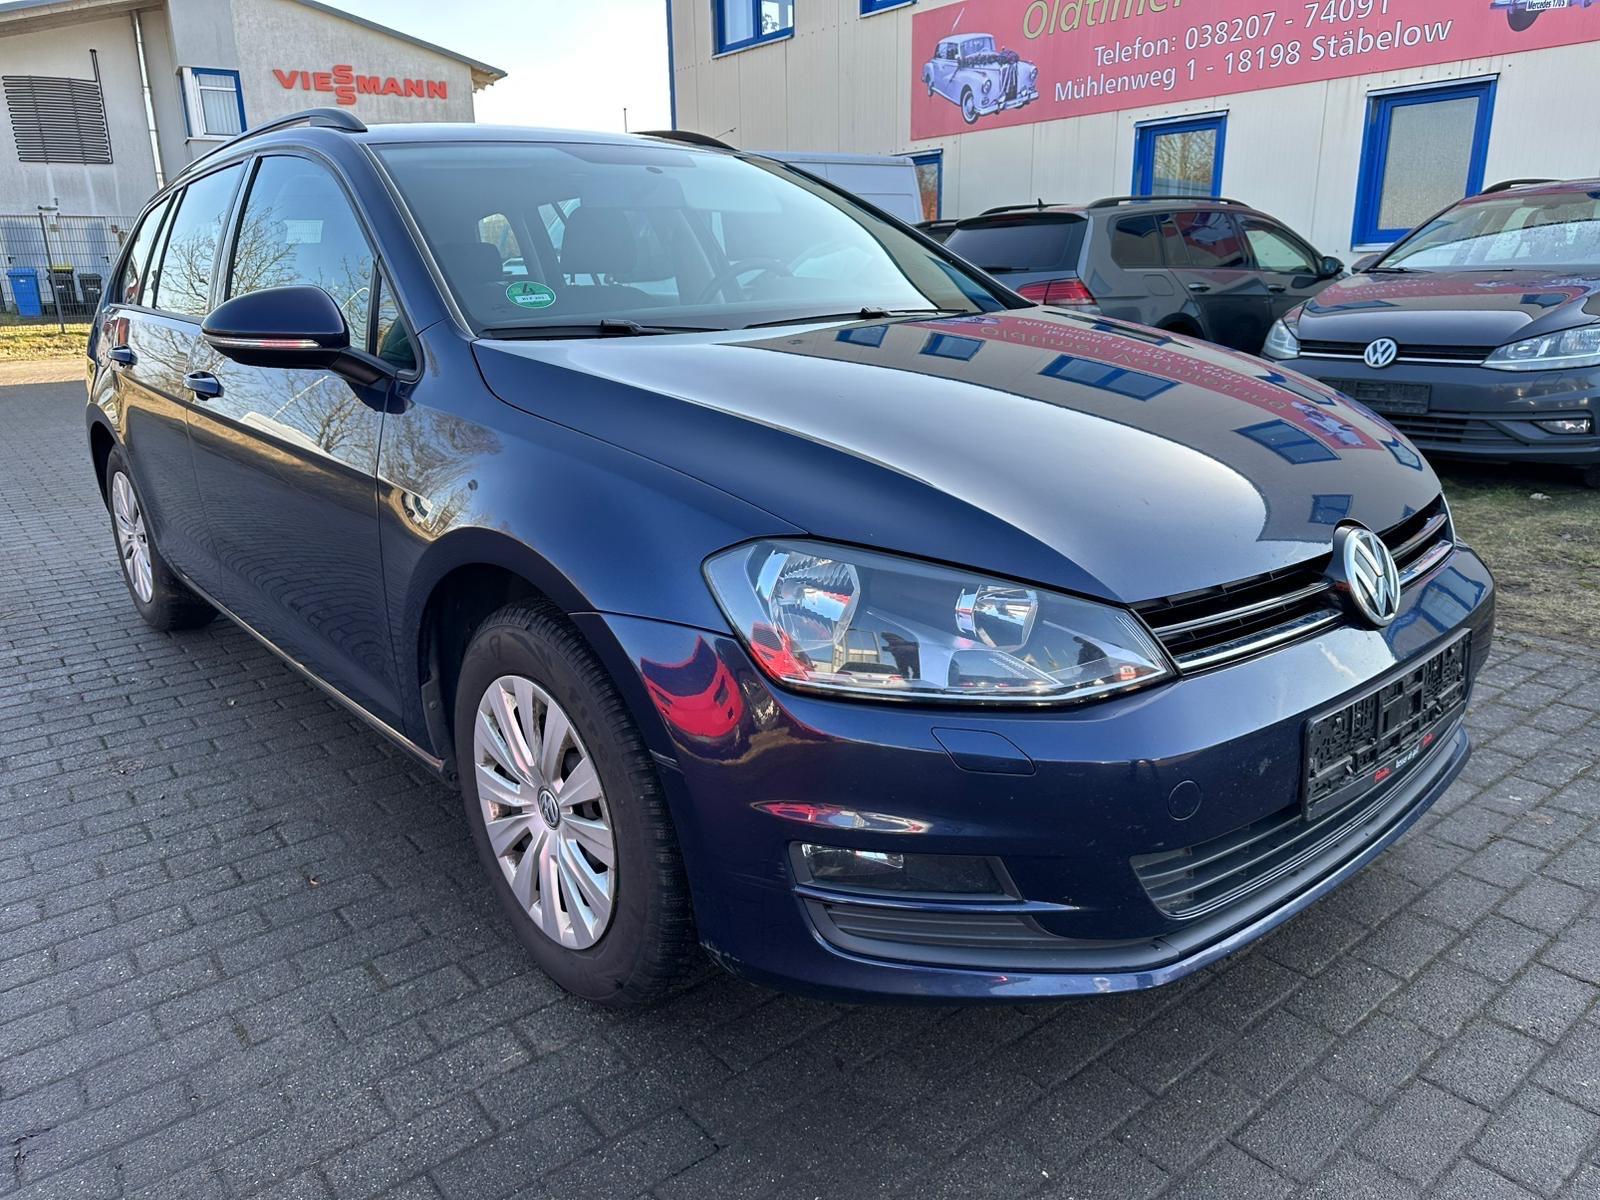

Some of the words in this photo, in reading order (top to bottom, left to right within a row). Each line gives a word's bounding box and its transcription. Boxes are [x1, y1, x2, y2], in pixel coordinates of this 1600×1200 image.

[1055, 67, 1176, 102] Mühlenweg
[1187, 59, 1196, 81] 1
[1225, 41, 1301, 75] 18198
[1311, 20, 1453, 61] Stäbelow
[1094, 36, 1177, 67] Telefon:
[1185, 11, 1276, 50] 038207
[272, 64, 448, 106] VIESSMANN
